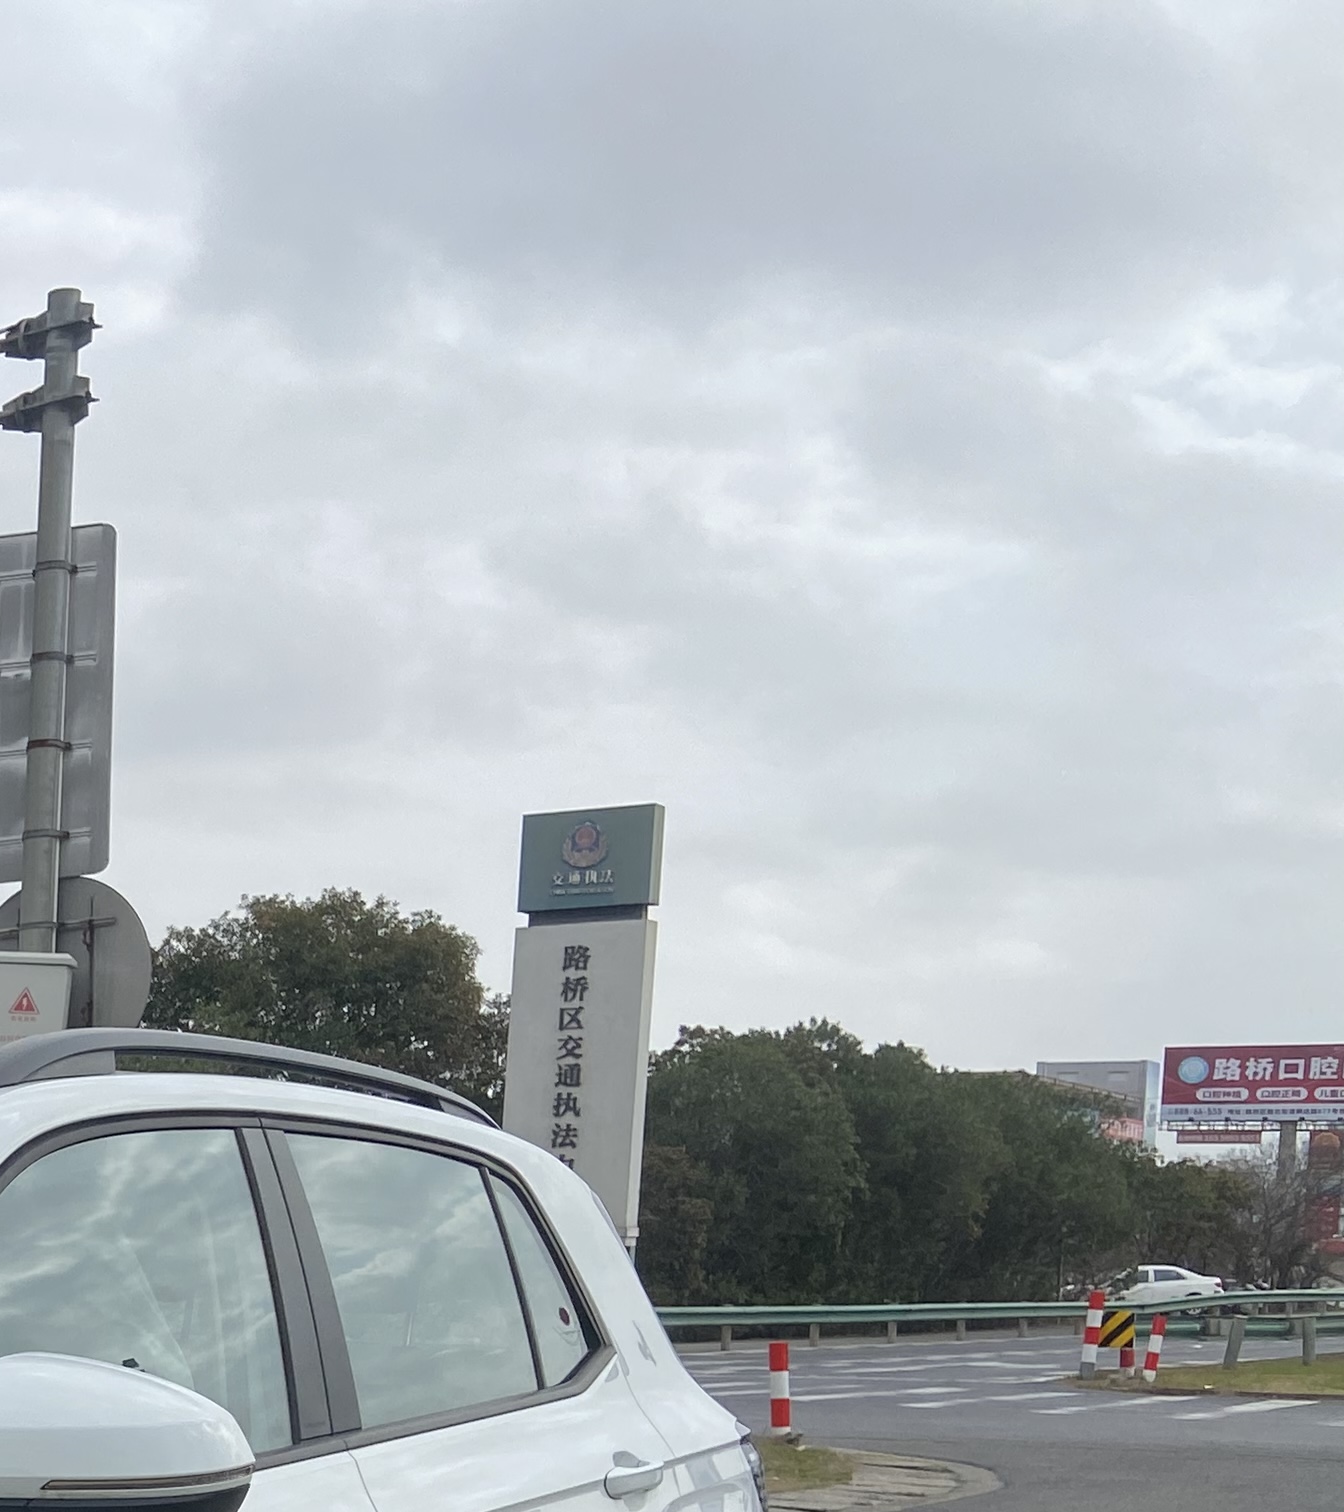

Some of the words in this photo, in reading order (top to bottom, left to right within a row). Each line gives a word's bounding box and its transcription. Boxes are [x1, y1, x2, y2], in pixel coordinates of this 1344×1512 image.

[552, 869, 614, 886] 交通执法
[1212, 1057, 1344, 1081] 路桥口腔
